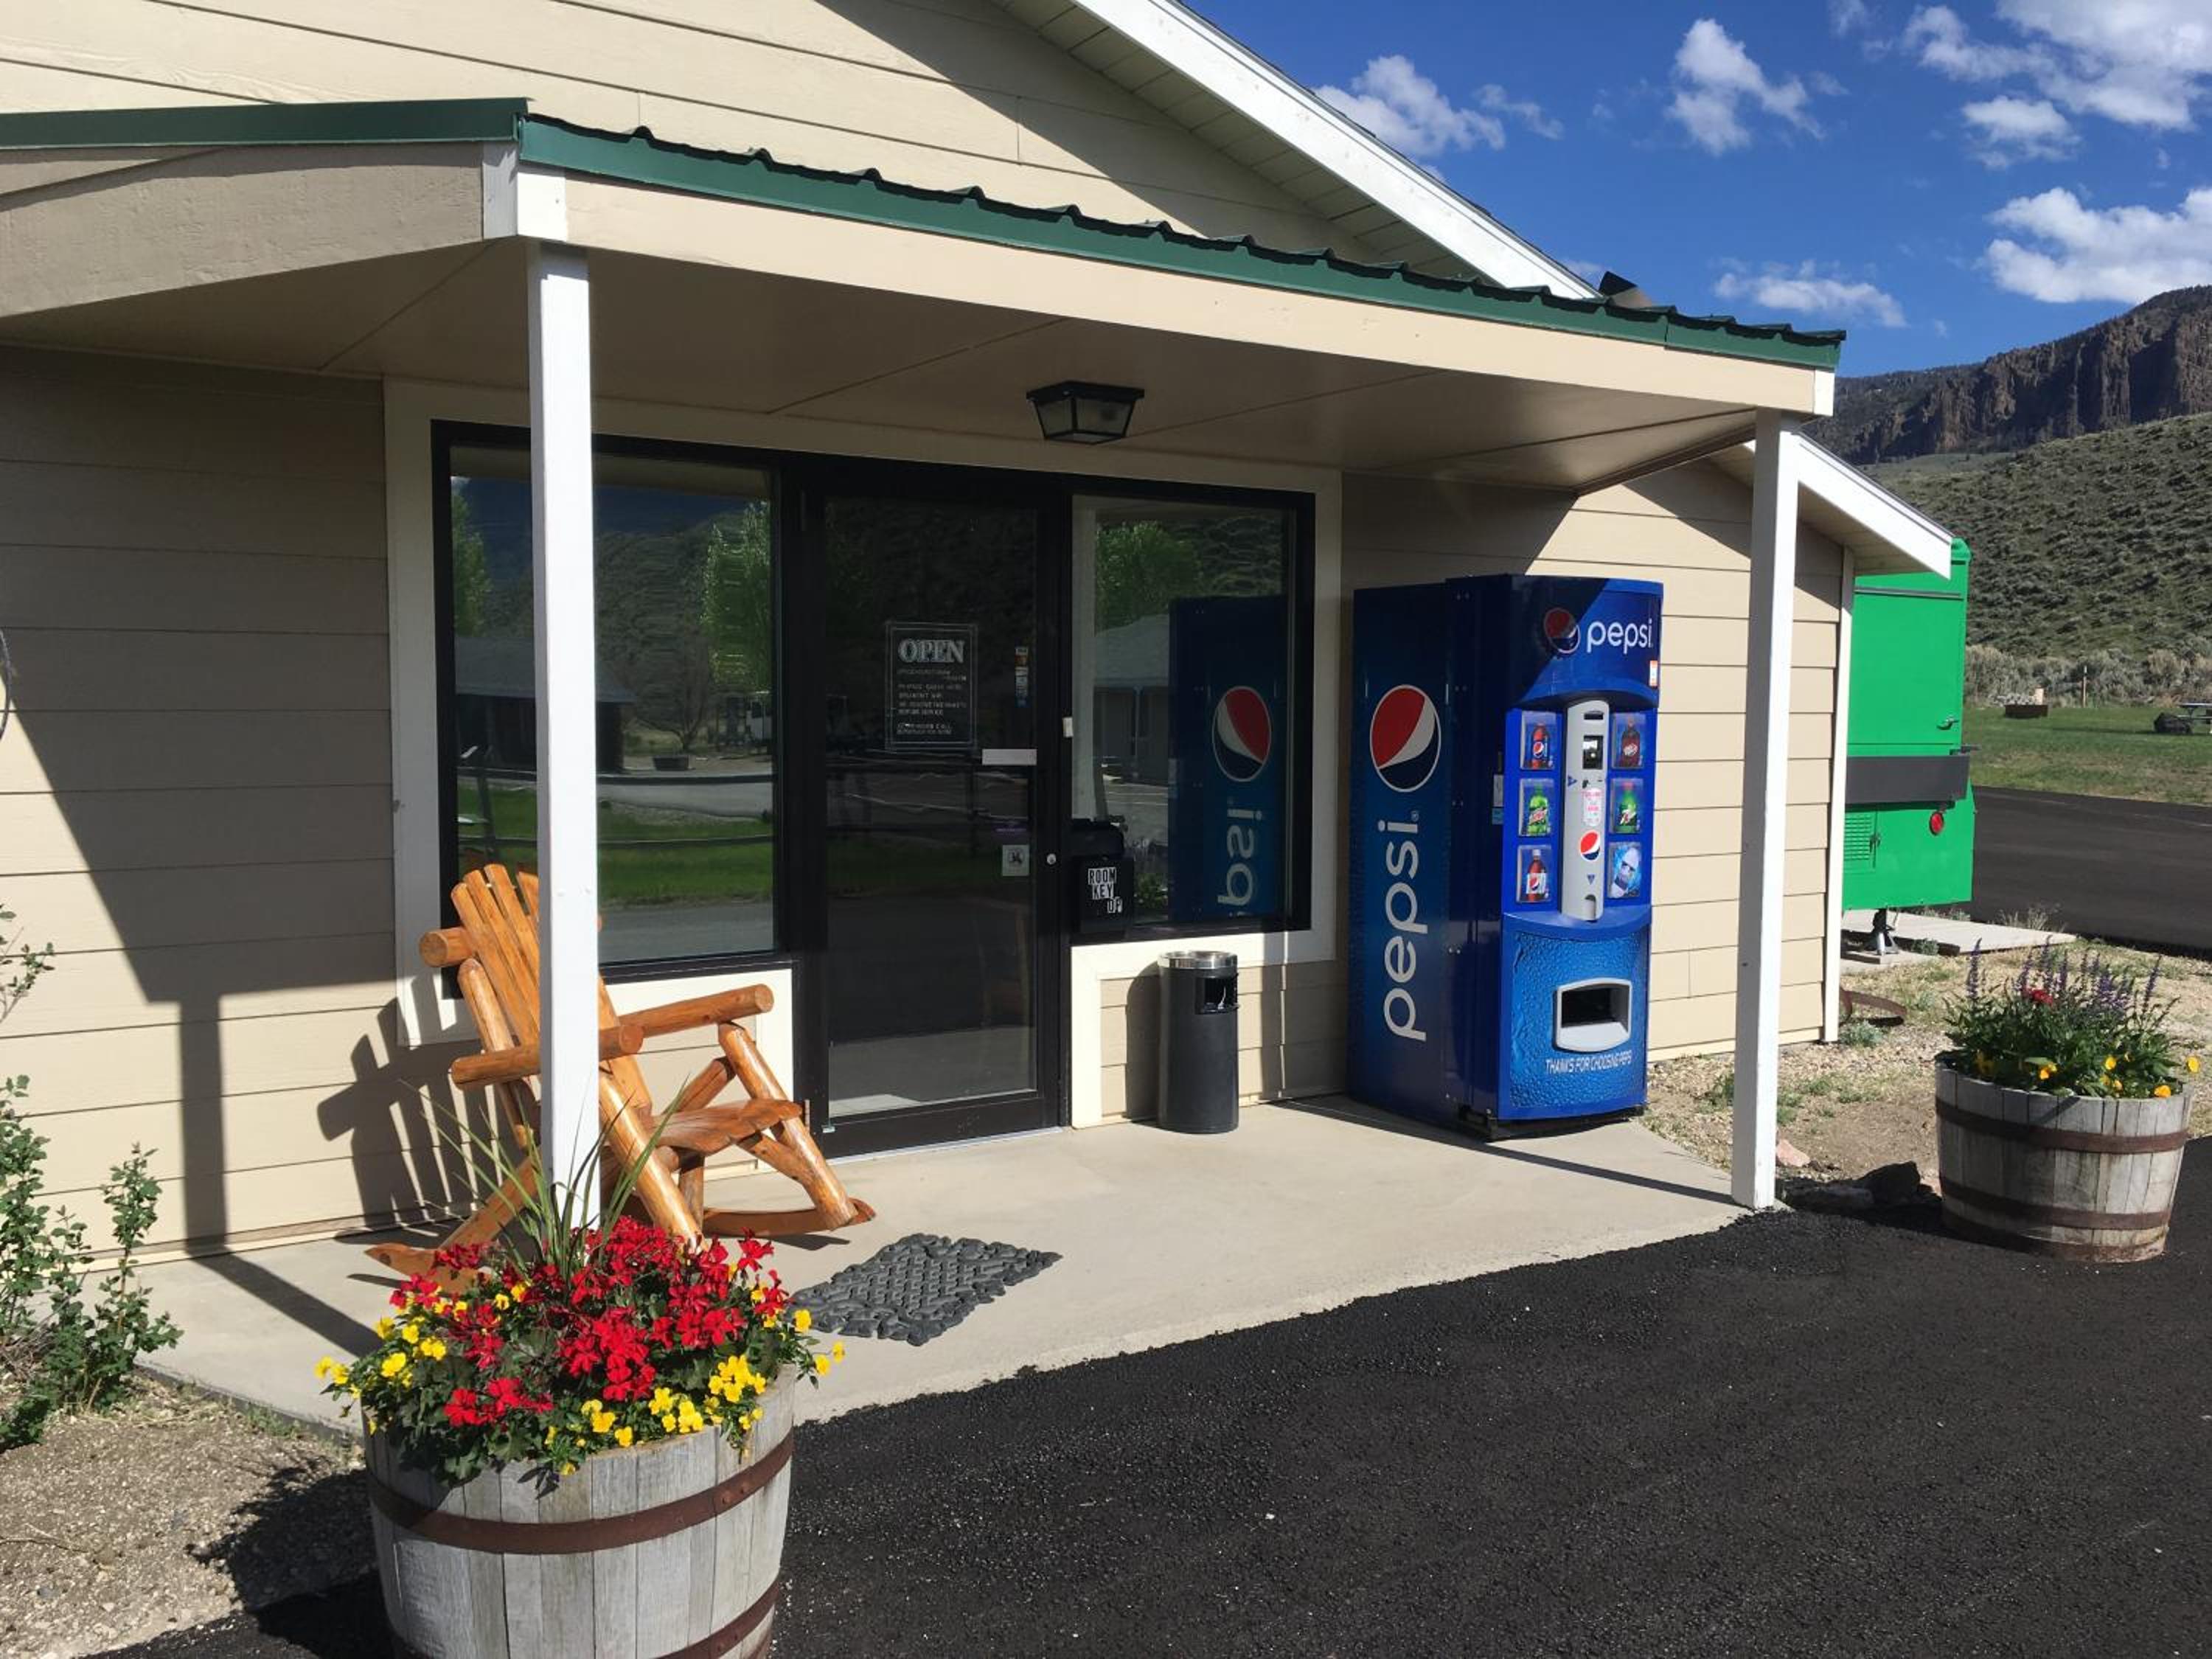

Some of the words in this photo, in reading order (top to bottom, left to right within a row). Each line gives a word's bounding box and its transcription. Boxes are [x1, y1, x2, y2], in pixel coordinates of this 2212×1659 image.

[1587, 618, 1652, 655] pepsi
[898, 639, 965, 663] OPEN
[1088, 867, 1116, 885] ROOM
[1093, 884, 1114, 900] KEY
[1377, 819, 1428, 1042] pepsi
[1545, 1058, 1574, 1074] THANKS
[1574, 1056, 1590, 1072] FOR
